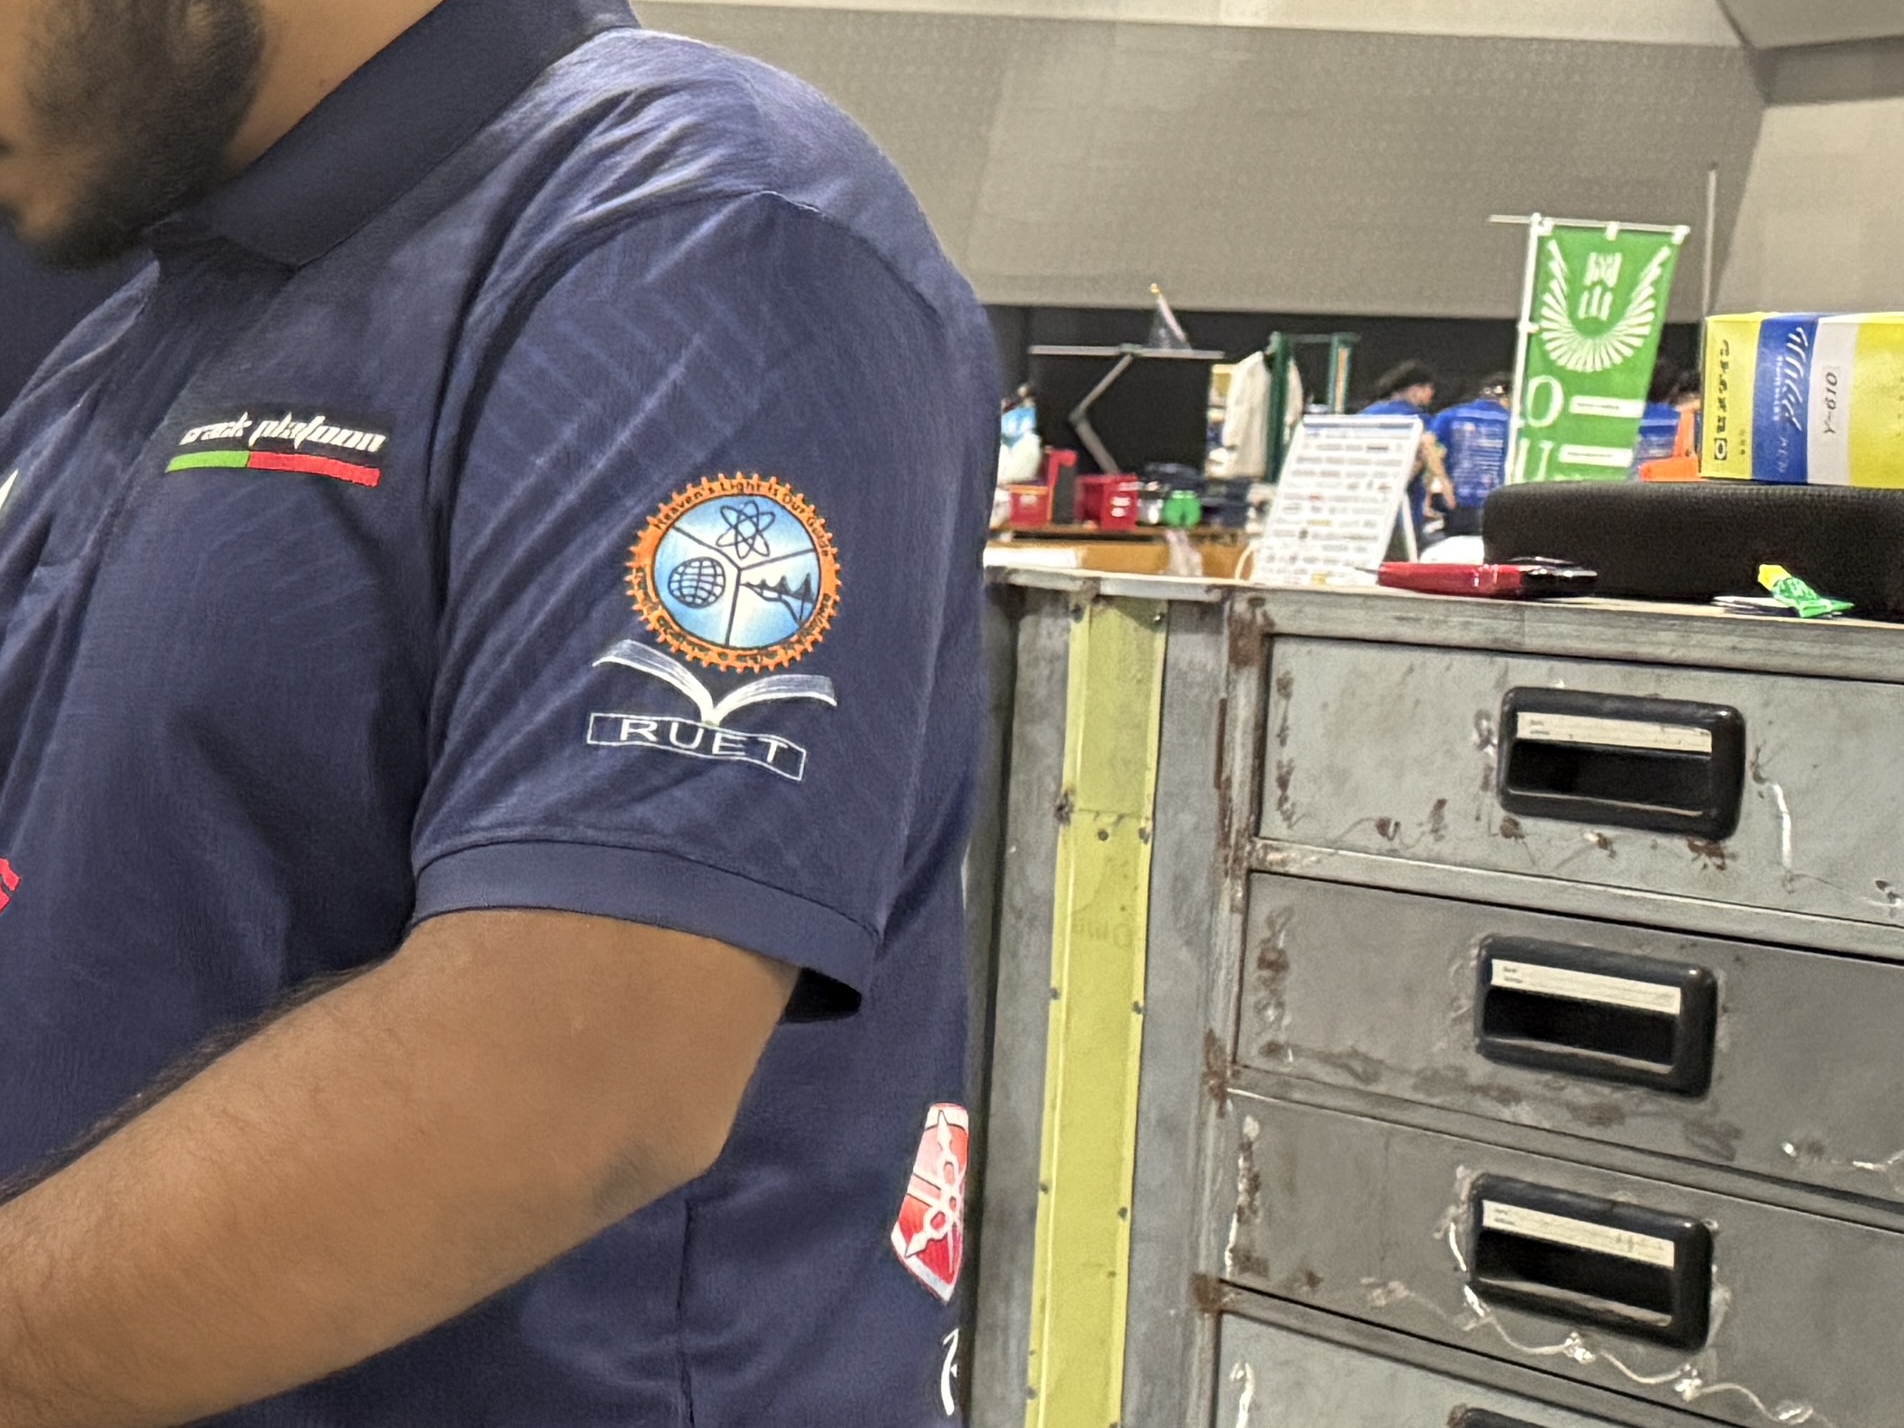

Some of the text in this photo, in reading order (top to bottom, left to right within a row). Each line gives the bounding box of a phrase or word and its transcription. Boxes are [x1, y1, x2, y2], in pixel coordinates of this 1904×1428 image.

[1526, 375, 1564, 428] O
[178, 412, 387, 453] crack platoon
[720, 480, 762, 493] Light
[782, 492, 807, 515] Our
[620, 718, 788, 763] RUET
